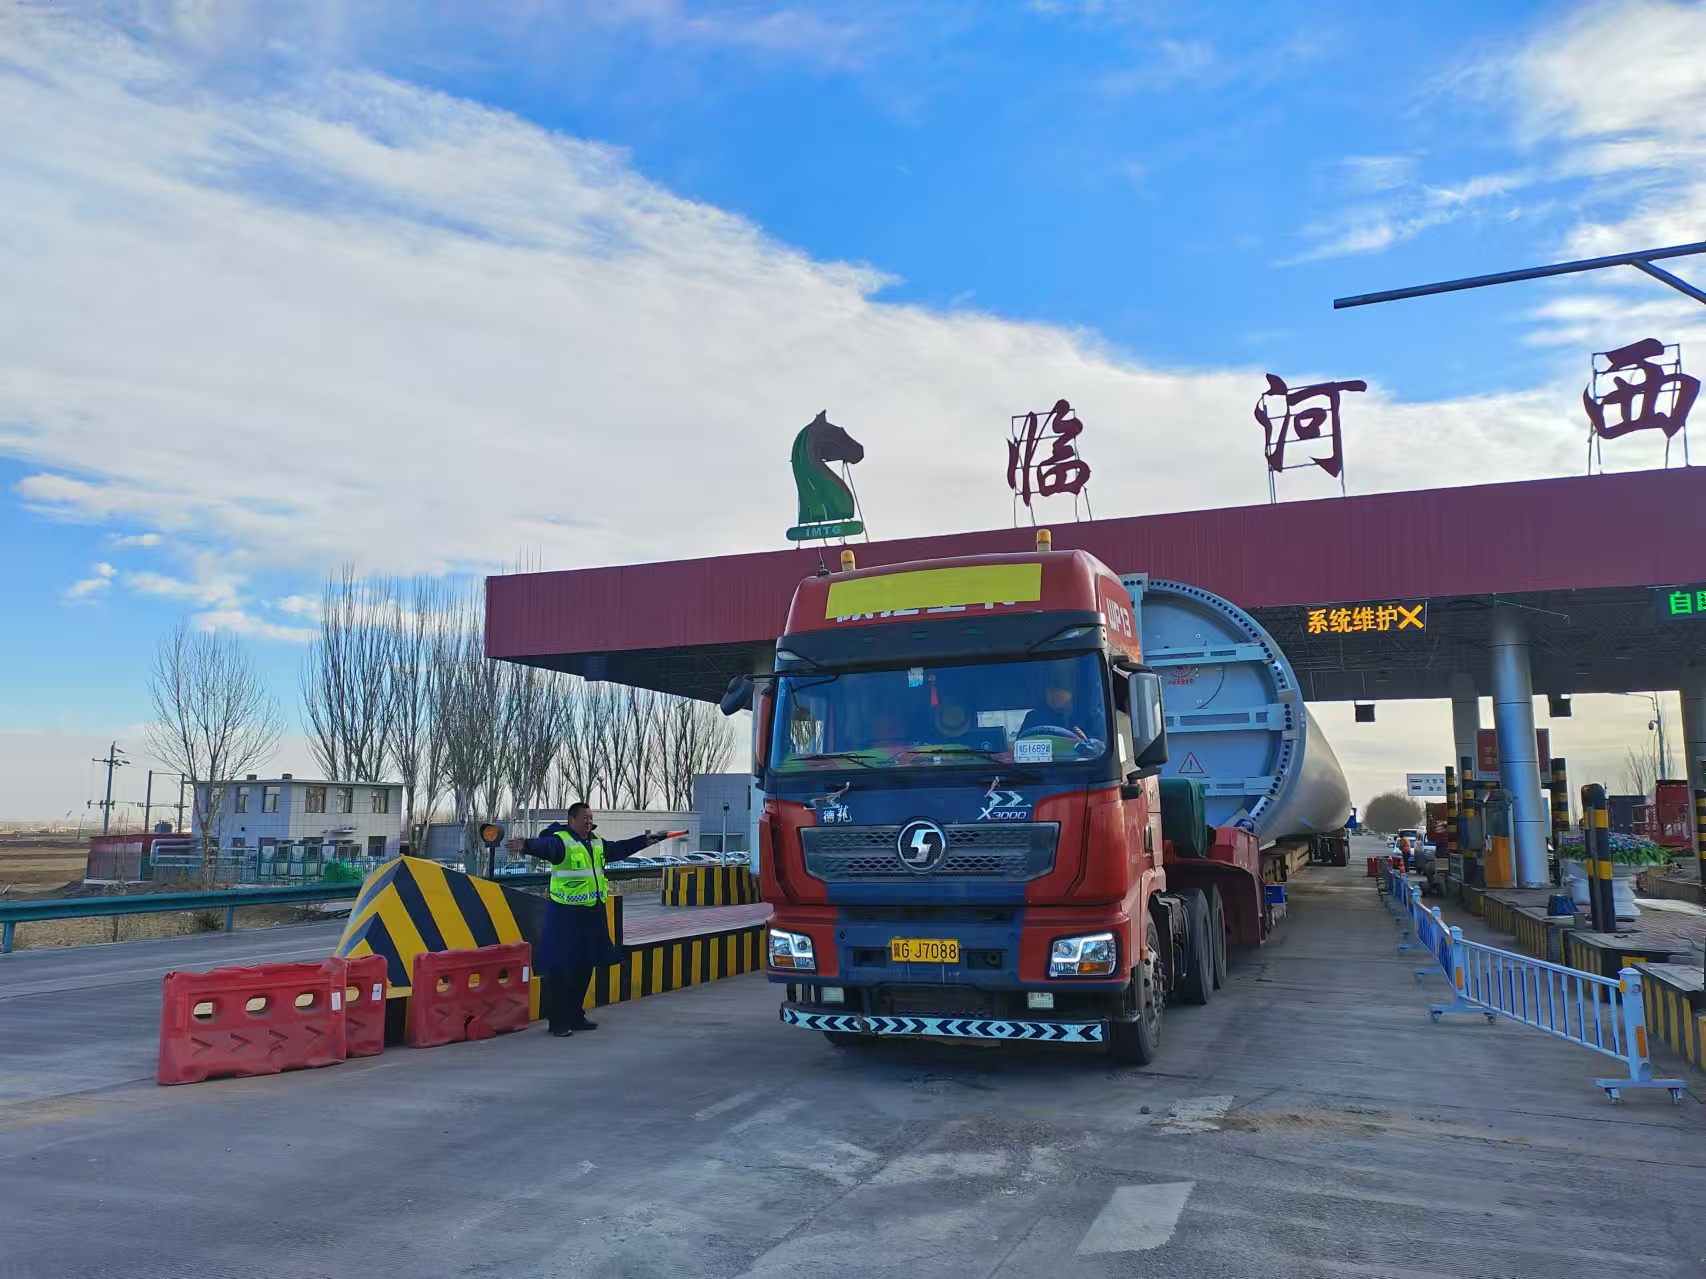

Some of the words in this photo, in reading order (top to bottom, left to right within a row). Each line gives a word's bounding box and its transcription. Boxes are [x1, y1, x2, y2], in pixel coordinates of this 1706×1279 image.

[805, 525, 842, 538] IMTG
[1106, 597, 1132, 638] WP13
[1307, 605, 1398, 634] 系统维护
[976, 806, 1027, 821] X3000
